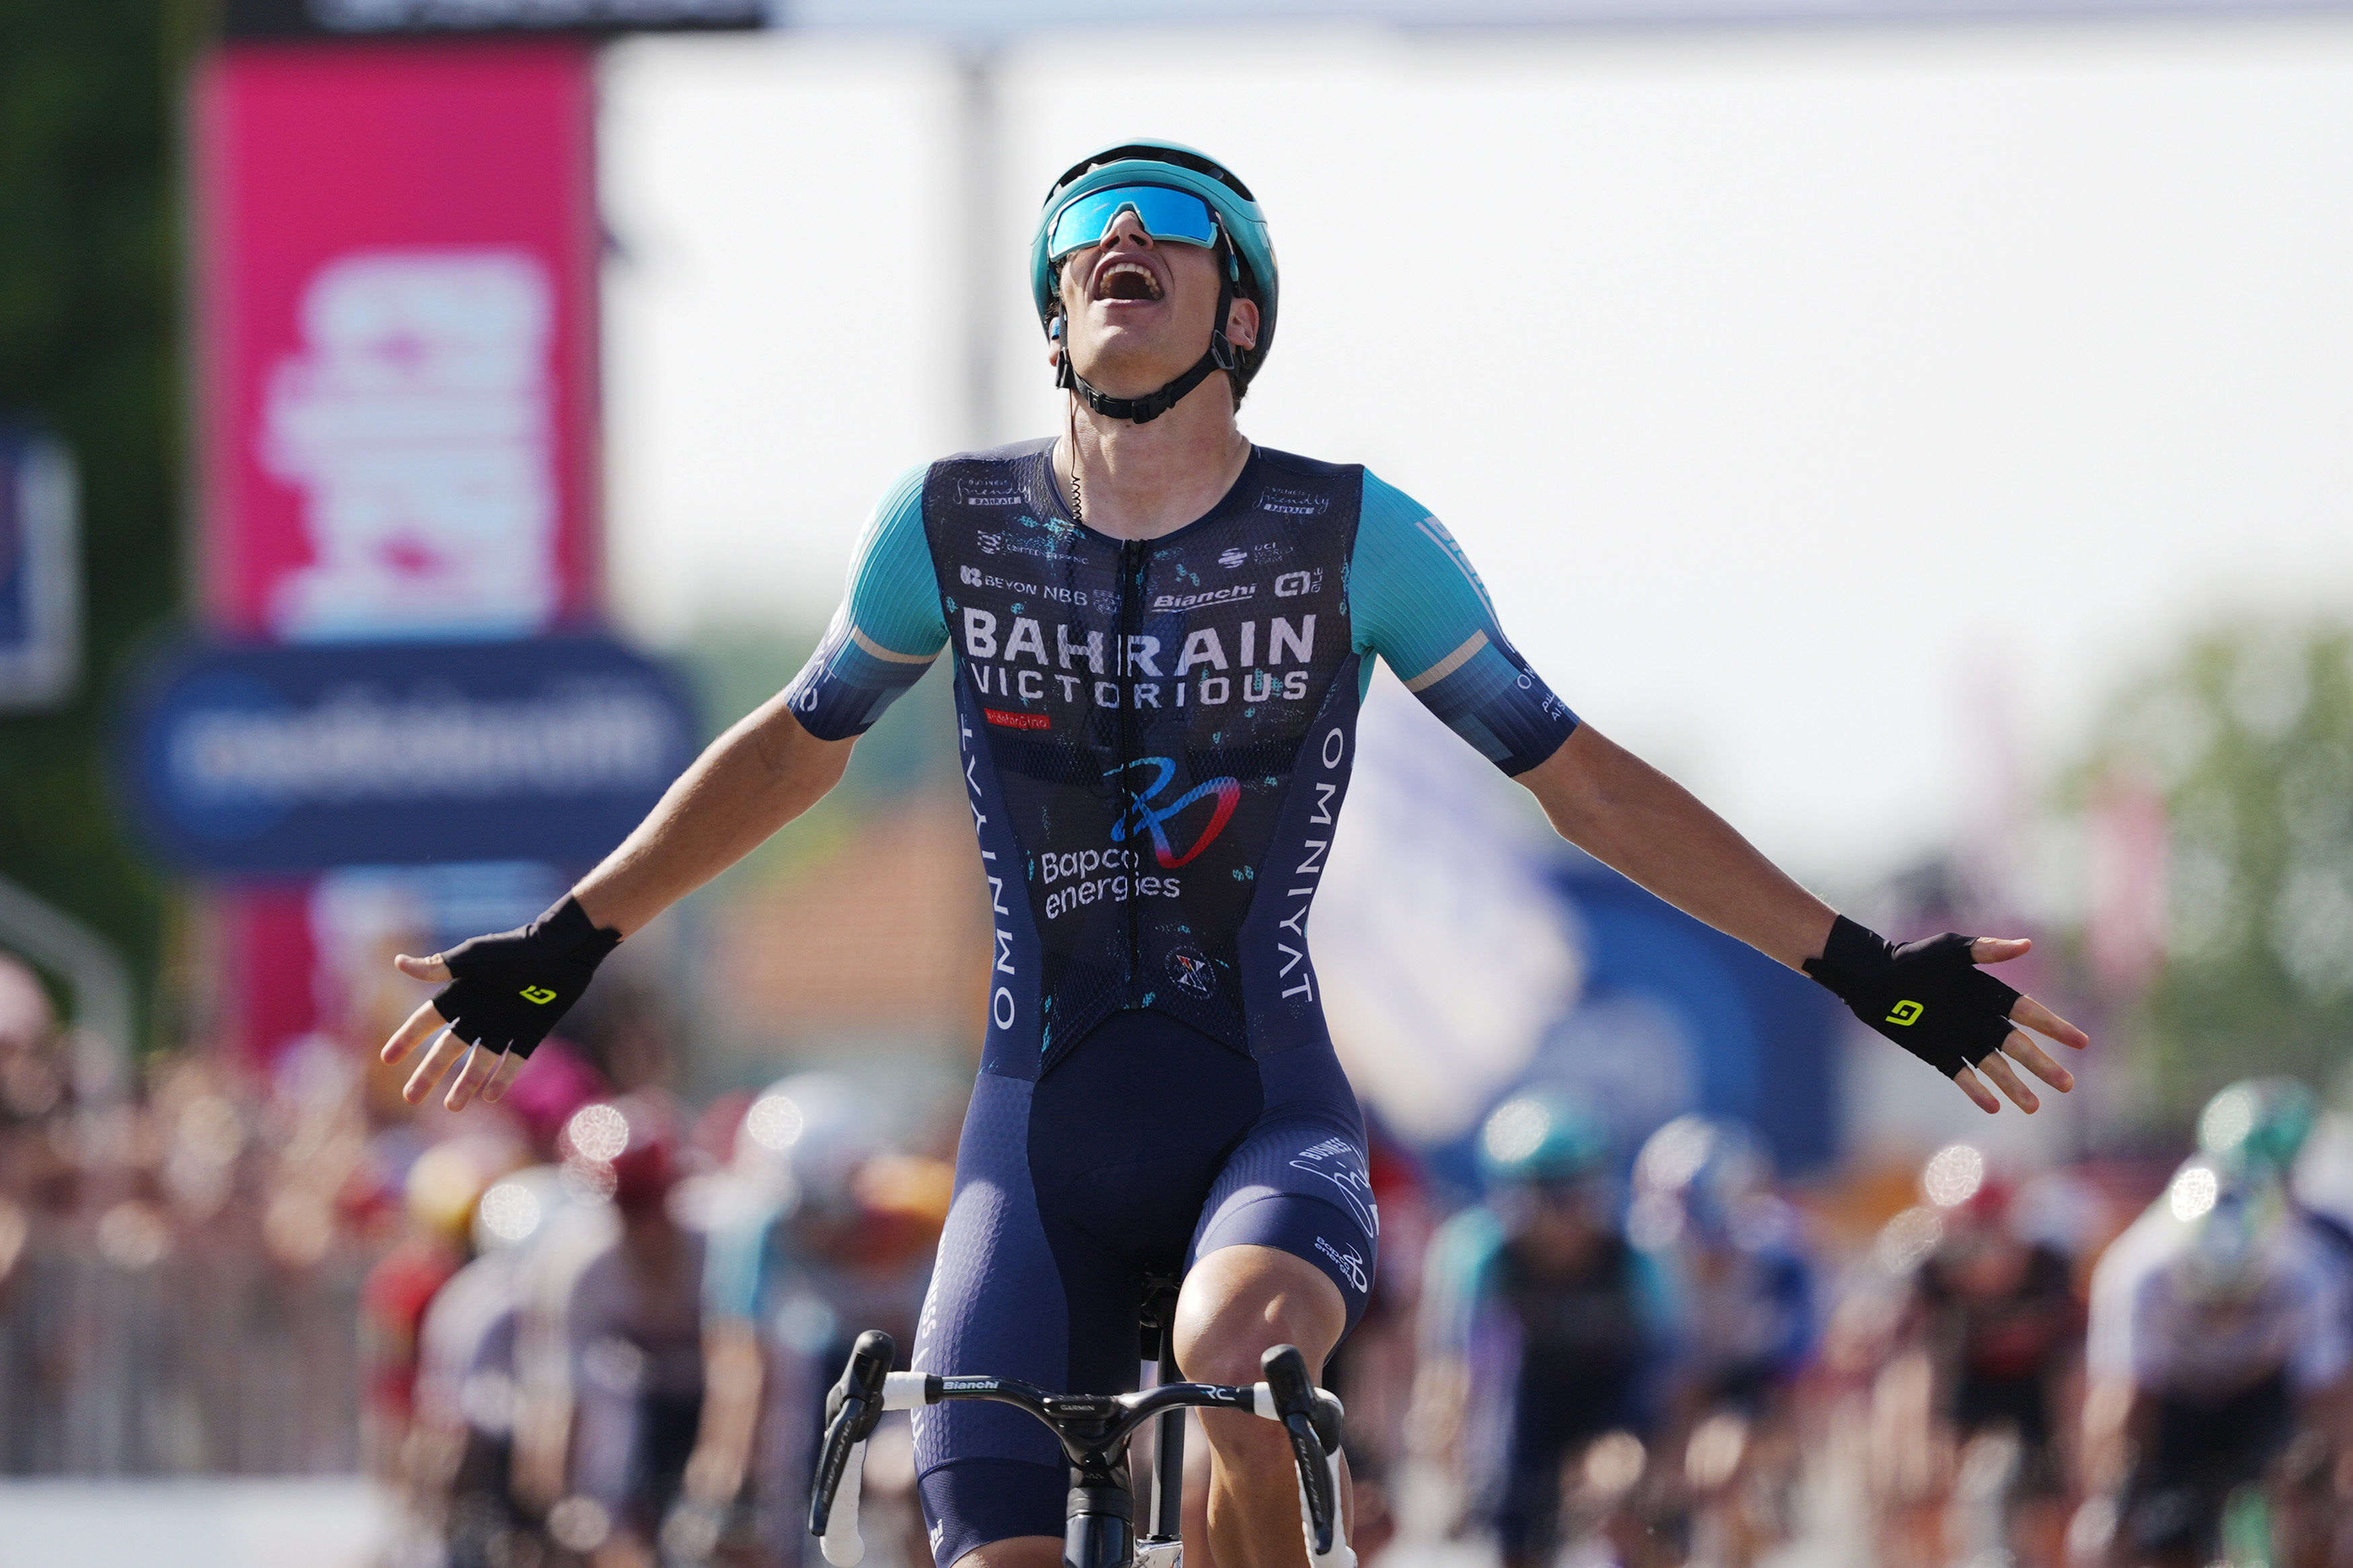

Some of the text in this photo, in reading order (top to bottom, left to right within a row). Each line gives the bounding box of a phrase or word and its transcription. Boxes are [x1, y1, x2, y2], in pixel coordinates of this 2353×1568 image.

[1254, 542, 1276, 551] UCI
[985, 575, 1037, 595] BEYON
[1043, 585, 1088, 606] NBB
[1154, 583, 1258, 608] Bianchi
[963, 607, 1316, 677] BAHRAIN
[970, 663, 1308, 709] VICTORIOUS
[961, 714, 1016, 1030] OMNIYAT
[1041, 848, 1139, 884] Bapco
[1277, 727, 1344, 1003] OMNIYAT
[1045, 871, 1181, 919] energies
[1298, 1137, 1352, 1161] BUSINESS
[1314, 1242, 1355, 1290] energies
[1316, 1235, 1350, 1271] Bapco
[943, 1380, 1000, 1390] Bianchi
[1195, 1384, 1236, 1401] RC
